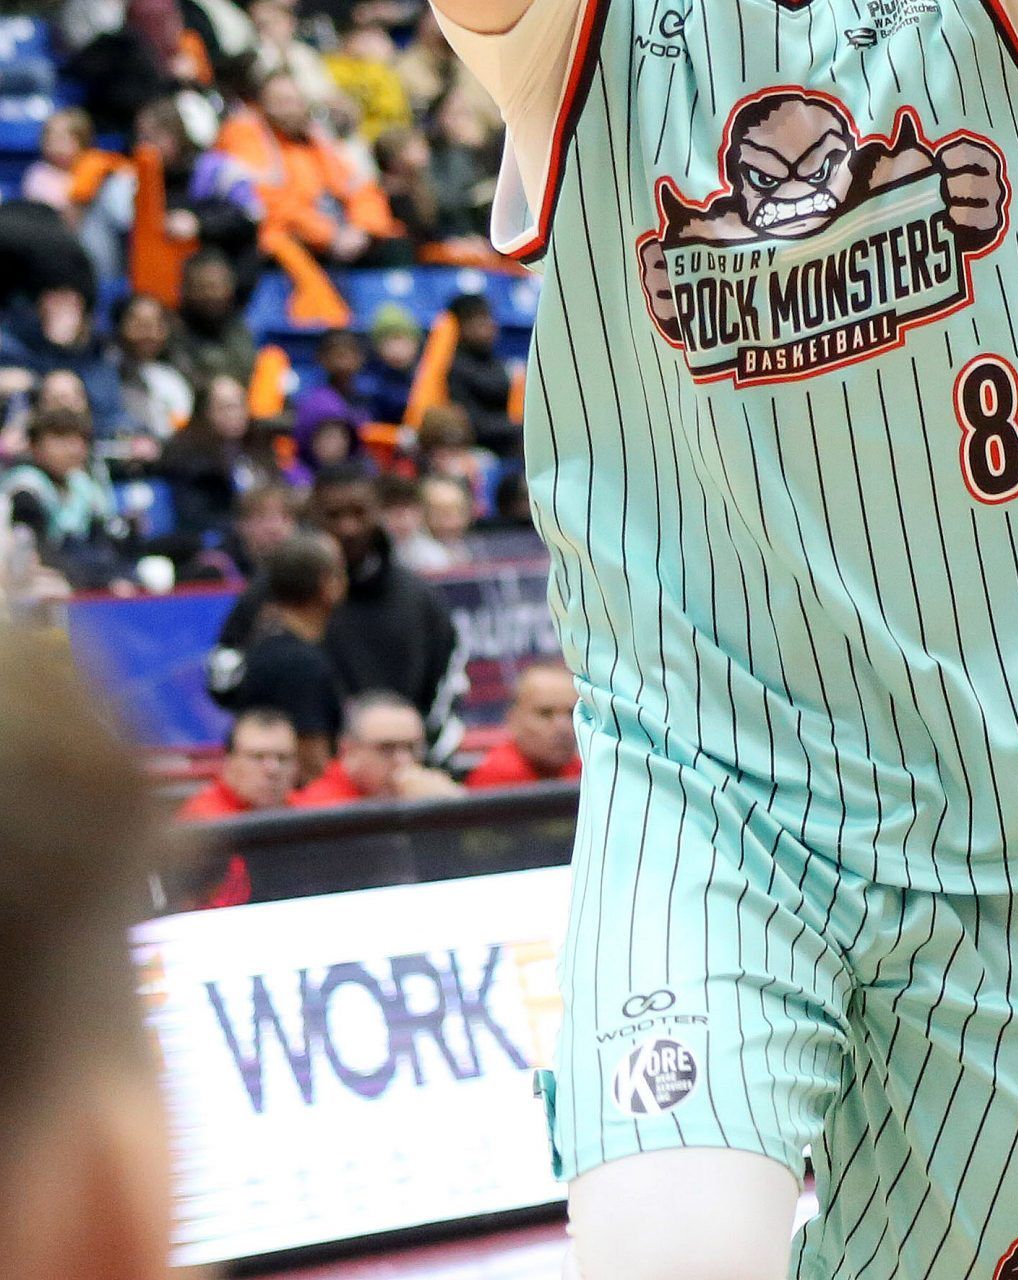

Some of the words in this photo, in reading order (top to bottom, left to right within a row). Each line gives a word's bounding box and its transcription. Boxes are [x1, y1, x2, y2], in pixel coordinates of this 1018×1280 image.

[673, 275, 762, 353] ROCK
[768, 213, 953, 341] MONSTERS
[674, 246, 777, 277] SUDBURY
[745, 315, 891, 373] BASKETBALL
[596, 1014, 709, 1044] WOOTER
[615, 1038, 694, 1114] KORE
